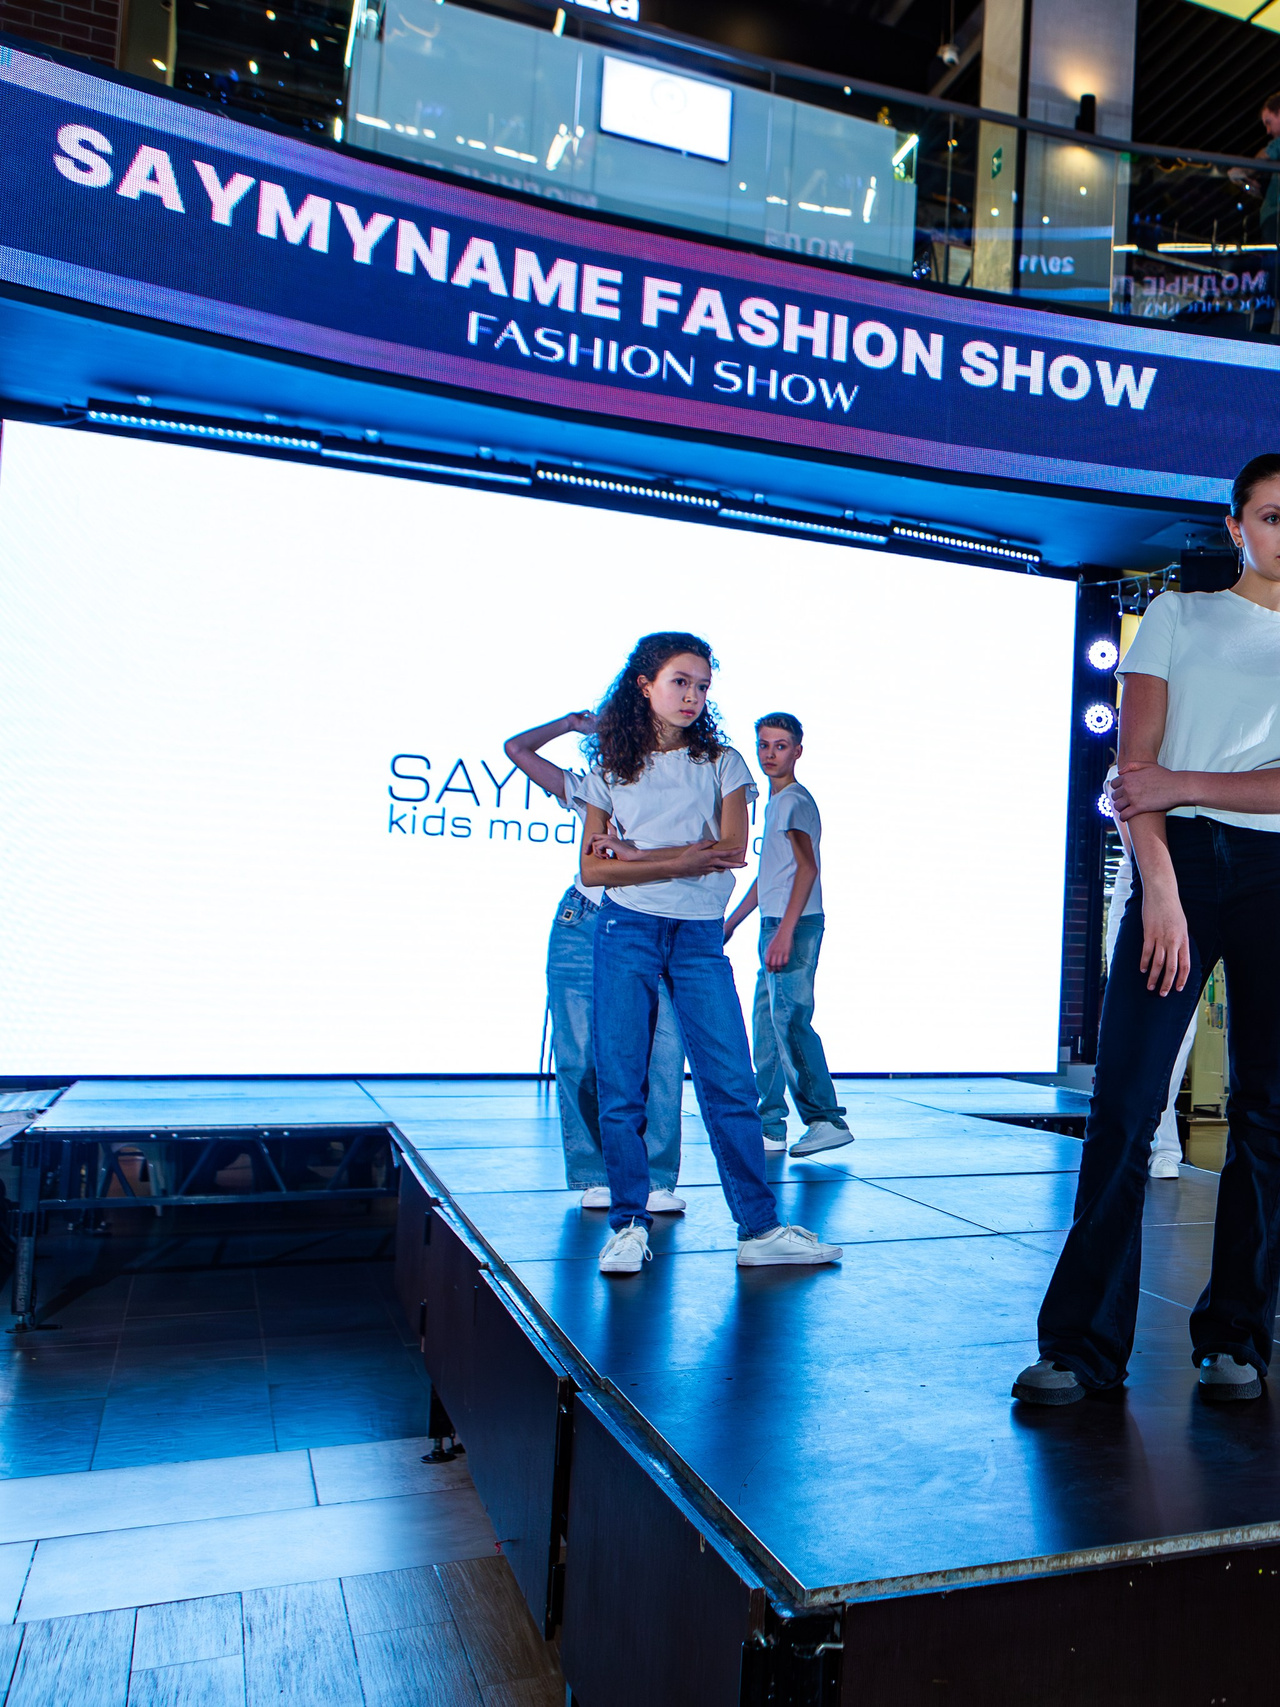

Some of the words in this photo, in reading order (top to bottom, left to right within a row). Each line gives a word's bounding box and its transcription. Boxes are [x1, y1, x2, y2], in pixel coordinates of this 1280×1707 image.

[53, 122, 622, 320] SAYMYNAME
[641, 276, 944, 381] FASHION
[959, 341, 1157, 411] SHOW
[467, 311, 695, 386] FASHION
[712, 361, 859, 414] SHOW
[388, 753, 572, 812] SAY
[388, 803, 472, 838] kids
[489, 816, 576, 844] mod
